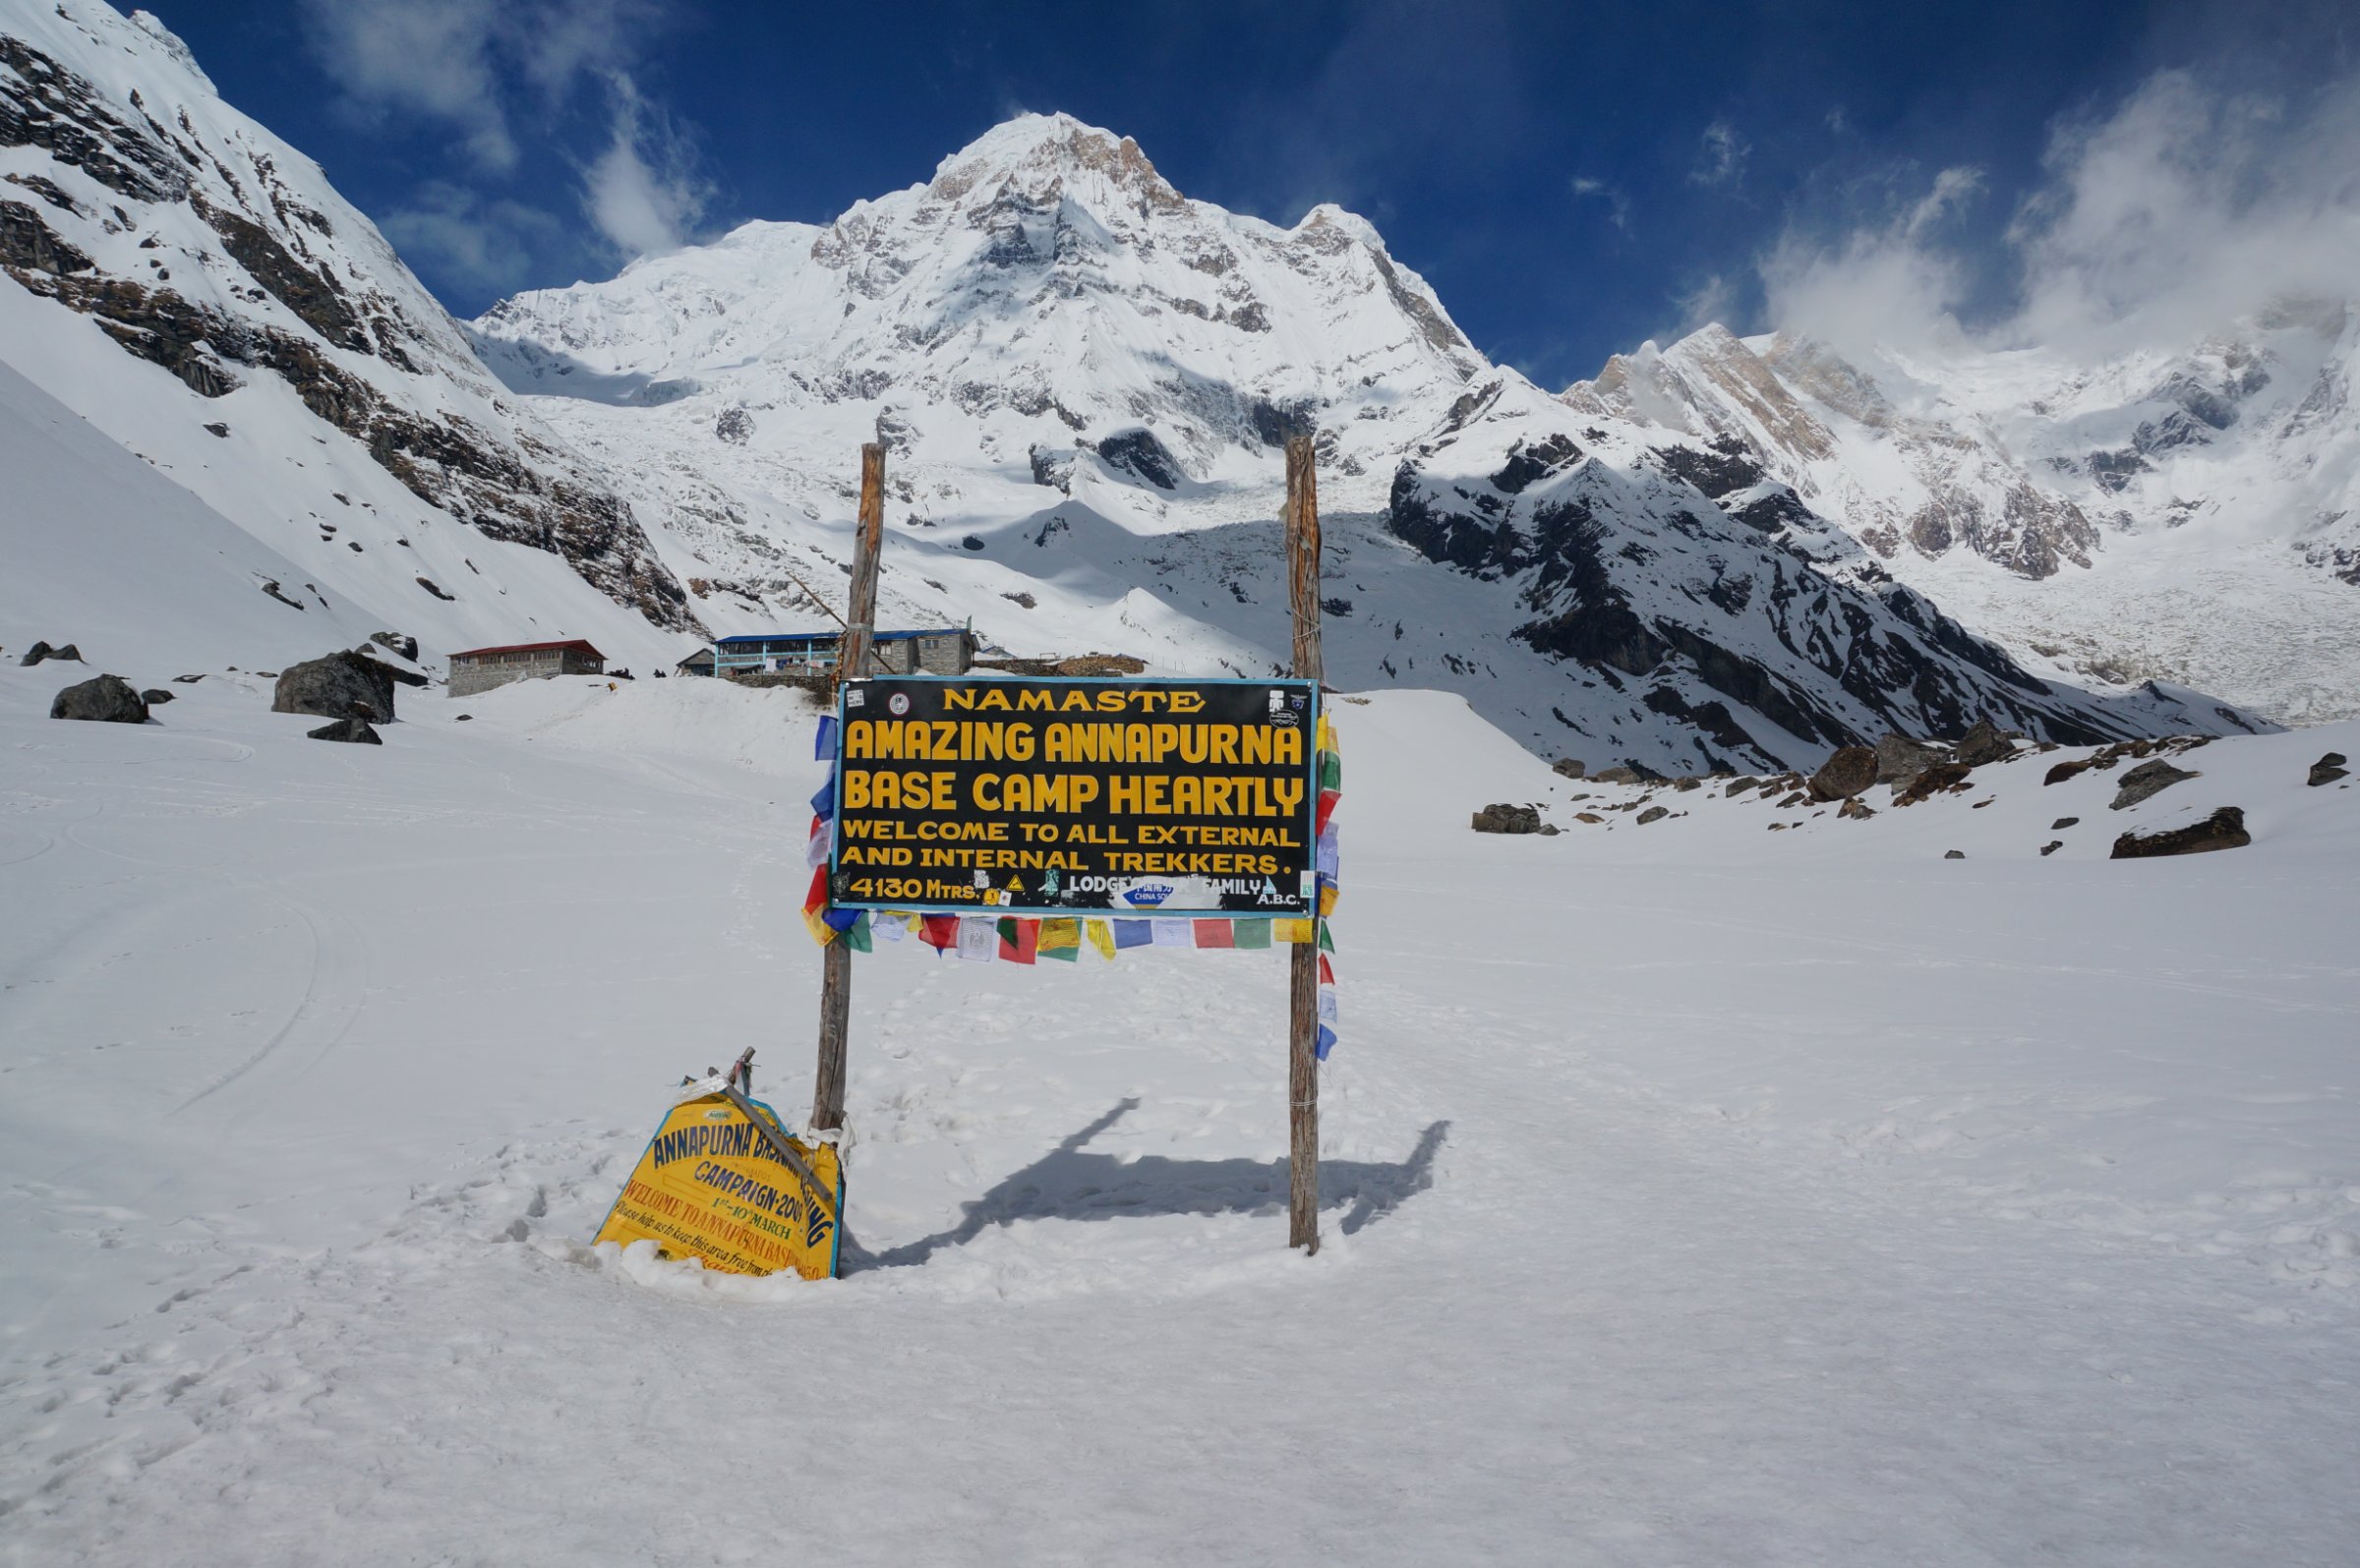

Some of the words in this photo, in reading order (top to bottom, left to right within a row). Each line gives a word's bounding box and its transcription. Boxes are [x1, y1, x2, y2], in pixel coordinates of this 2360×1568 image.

[943, 688, 1207, 713] NAMASTE
[846, 720, 1035, 762] AMAZING
[1044, 723, 1302, 766] ANNAPURNA
[844, 770, 957, 810] BASE
[972, 773, 1099, 814] CAMP
[1109, 775, 1304, 817] HEARTLY
[843, 819, 1009, 842] WELCOME
[1020, 823, 1059, 842] TO
[1067, 824, 1129, 844] ALL
[1138, 825, 1301, 847] EXTERNAL
[840, 845, 913, 866] AND
[919, 848, 1089, 871] INTERNAL
[850, 878, 923, 899] 4130
[1204, 878, 1261, 896] FAMILY
[1256, 894, 1300, 905] A.B.C.
[654, 1123, 754, 1170] ANNAPURNA
[623, 1179, 683, 1218] WELCOME
[748, 1212, 792, 1241] MARCH
